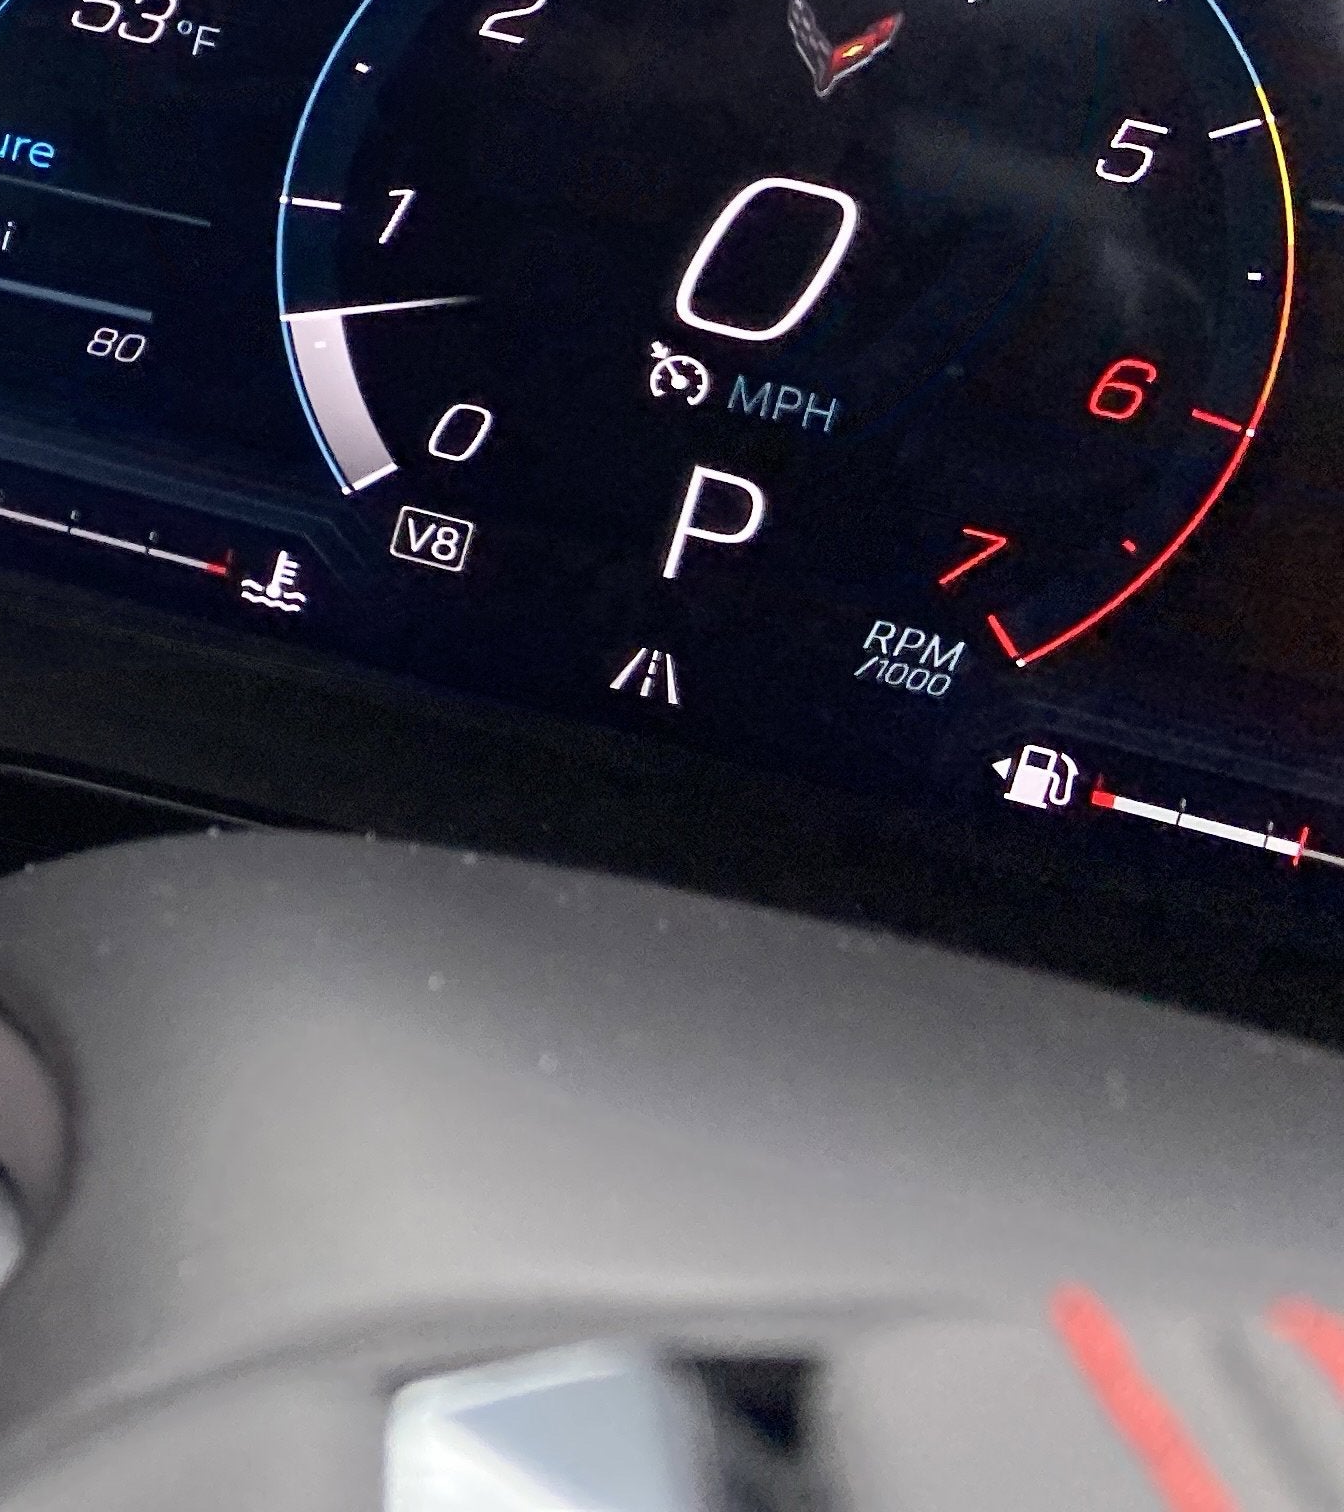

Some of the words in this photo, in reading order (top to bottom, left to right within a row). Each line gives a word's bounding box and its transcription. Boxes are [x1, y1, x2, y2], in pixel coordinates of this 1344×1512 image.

[1095, 118, 1169, 184] 5
[378, 188, 416, 245] 1
[675, 177, 859, 341] 0
[86, 327, 147, 363] 80
[726, 375, 837, 432] MPH
[1088, 358, 1157, 420] 6
[428, 403, 494, 462] 0
[407, 516, 460, 561] V8
[662, 464, 766, 579] P
[938, 528, 1008, 585] 7
[862, 619, 967, 672] RPM
[853, 655, 953, 696] /1000
